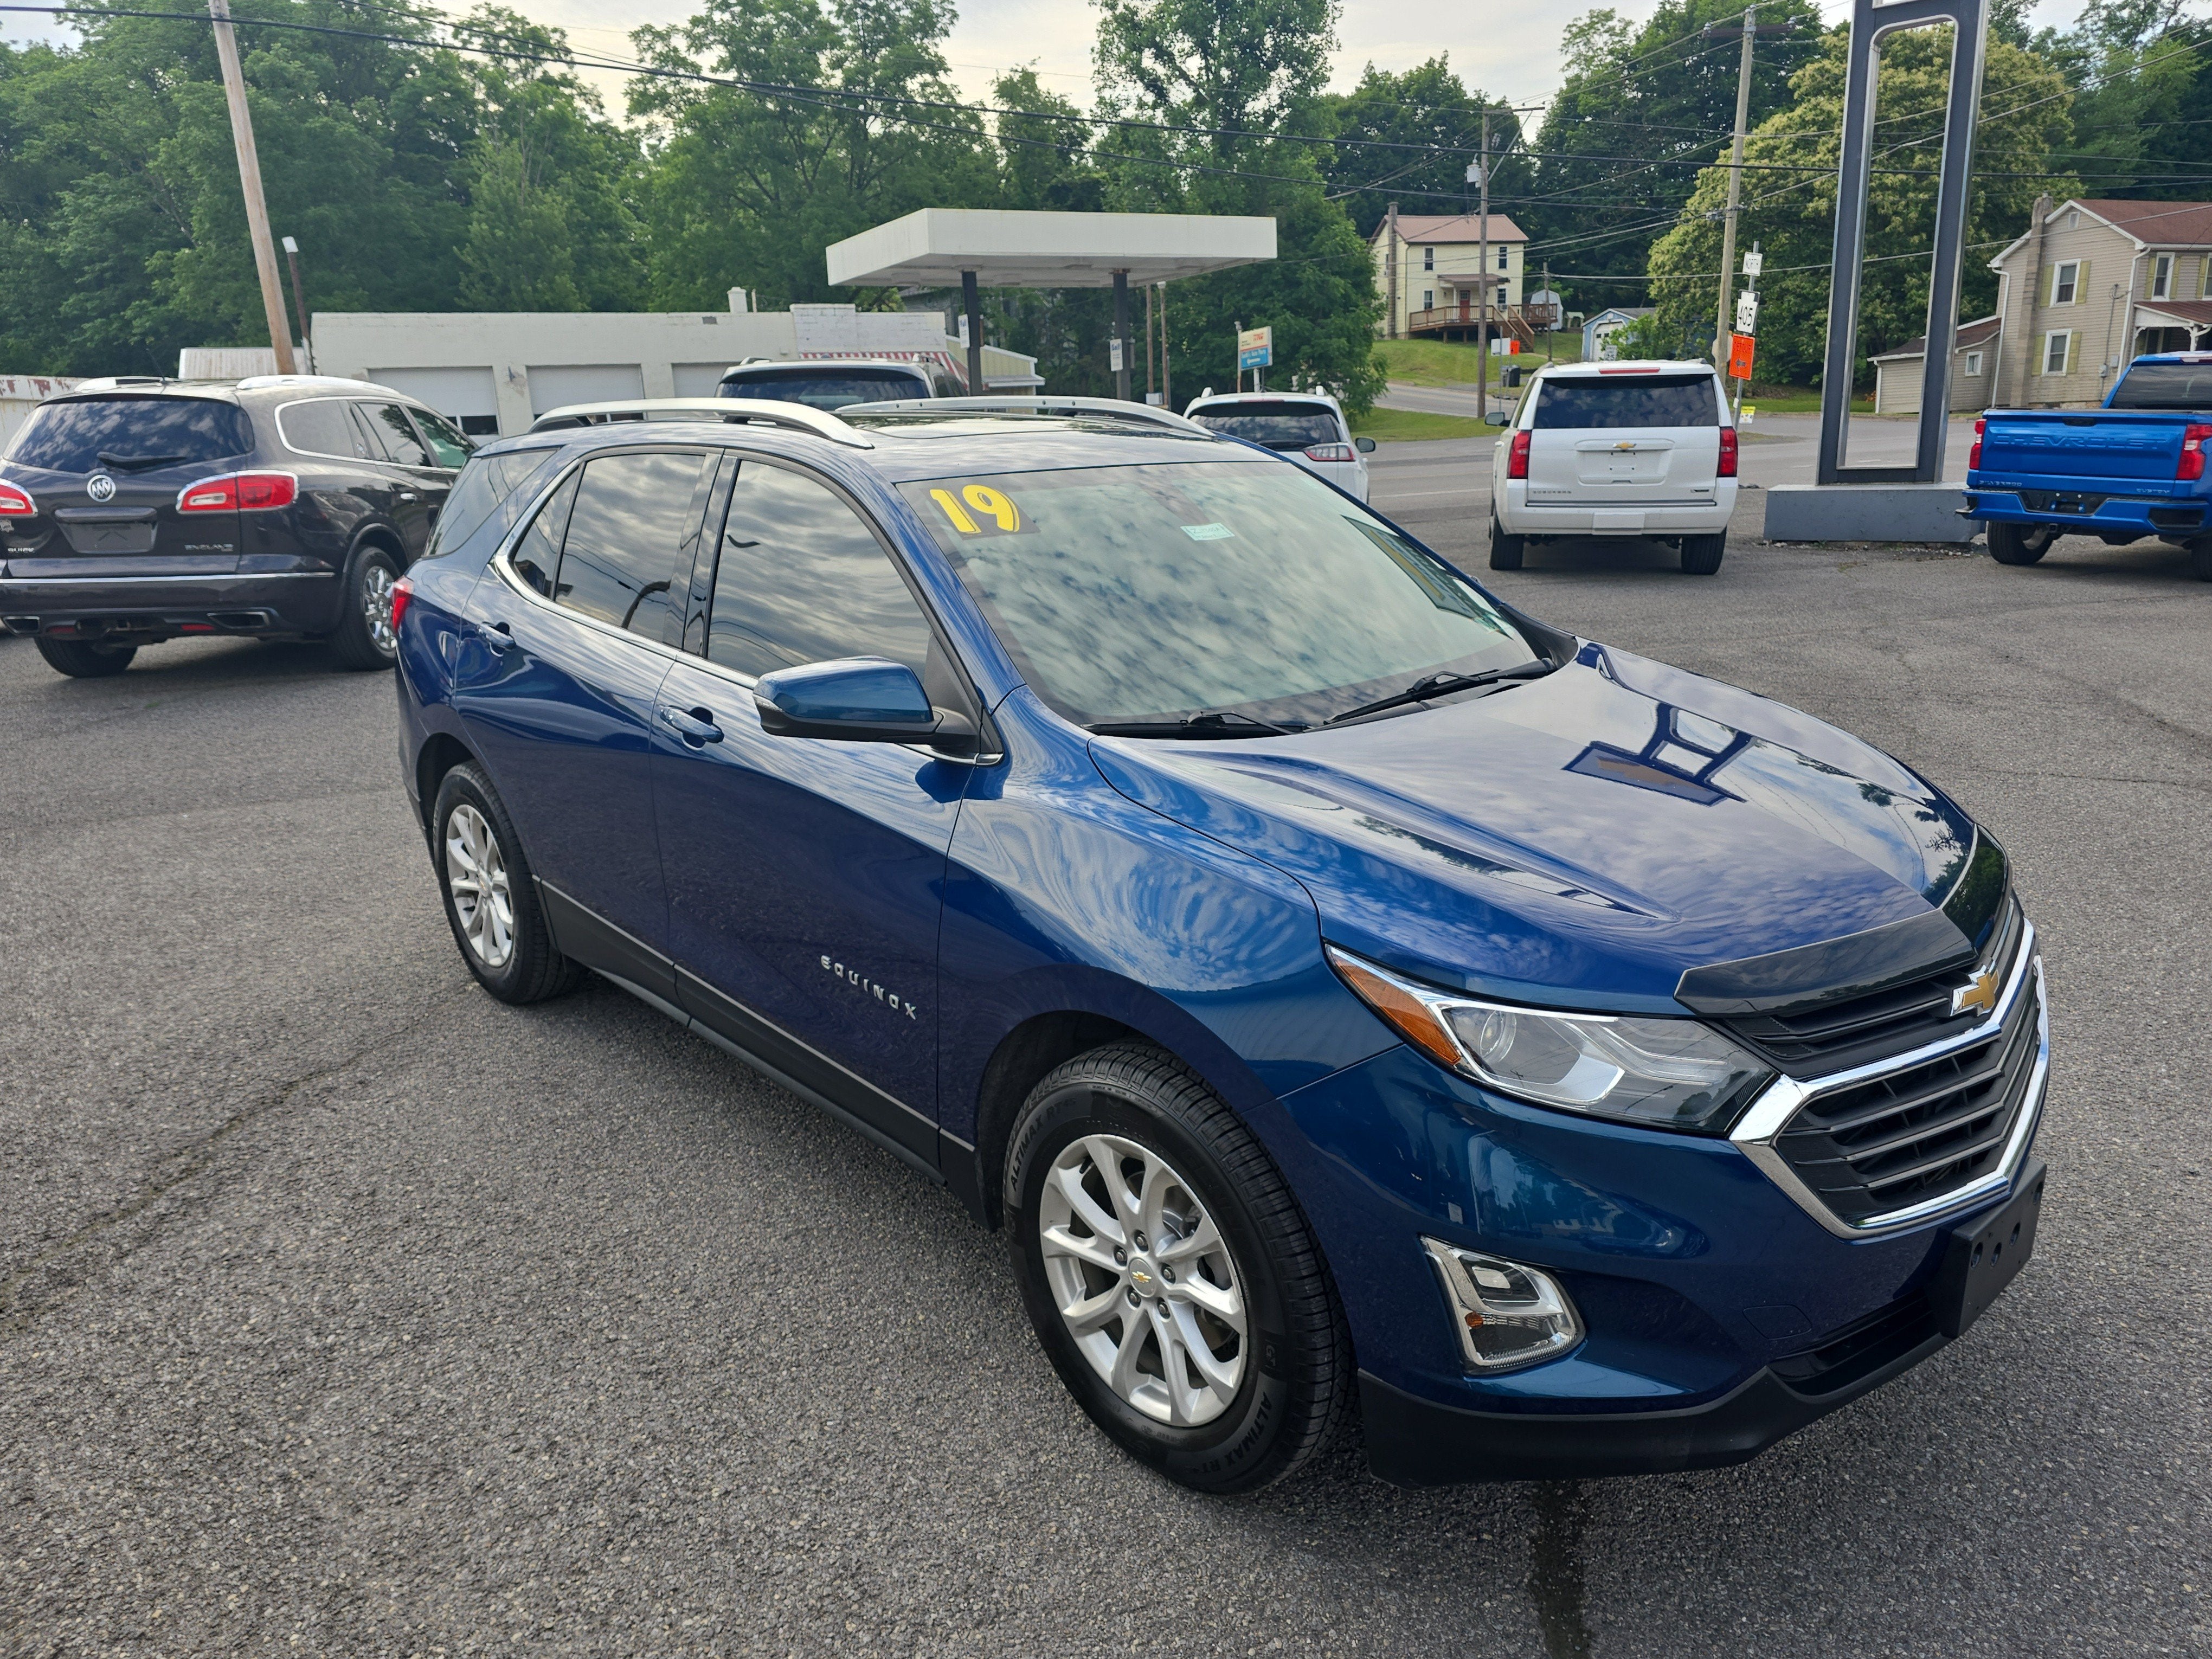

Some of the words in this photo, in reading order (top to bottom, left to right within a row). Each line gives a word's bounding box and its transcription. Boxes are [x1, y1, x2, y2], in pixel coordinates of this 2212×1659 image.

[1738, 306, 1753, 326] 405
[1993, 435, 2168, 450] CHEVROLET
[929, 484, 1020, 533] 19
[821, 955, 917, 1020] EQUINOX
[1011, 1115, 1044, 1192] ALTIMAX
[1224, 1391, 1272, 1467] ALTIMAX
